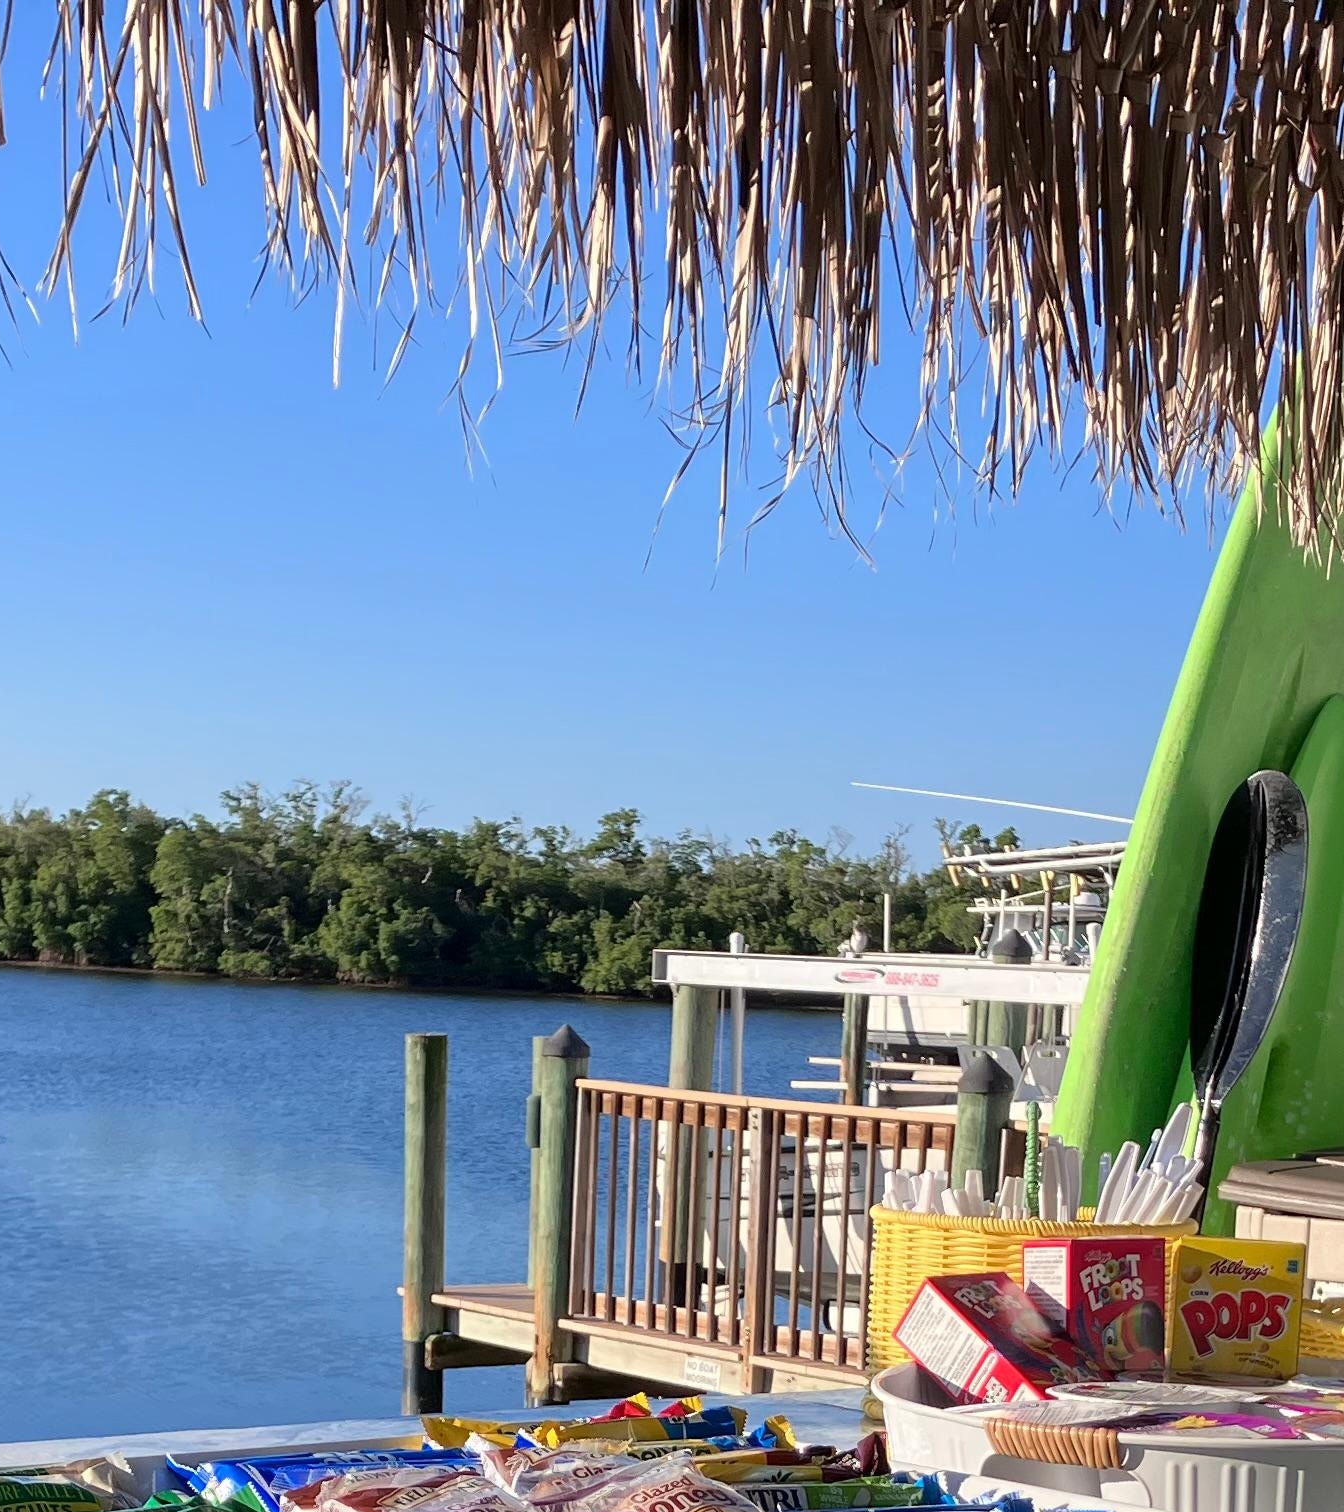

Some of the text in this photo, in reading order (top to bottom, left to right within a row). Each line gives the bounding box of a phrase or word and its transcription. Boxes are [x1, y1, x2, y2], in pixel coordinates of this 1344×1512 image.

[1079, 1254, 1140, 1293] FROOT
[1209, 1259, 1270, 1280] Kellogg's
[1087, 1278, 1144, 1312] LOOPS
[1180, 1289, 1291, 1357] POPS
[630, 1474, 696, 1504] Glazed
